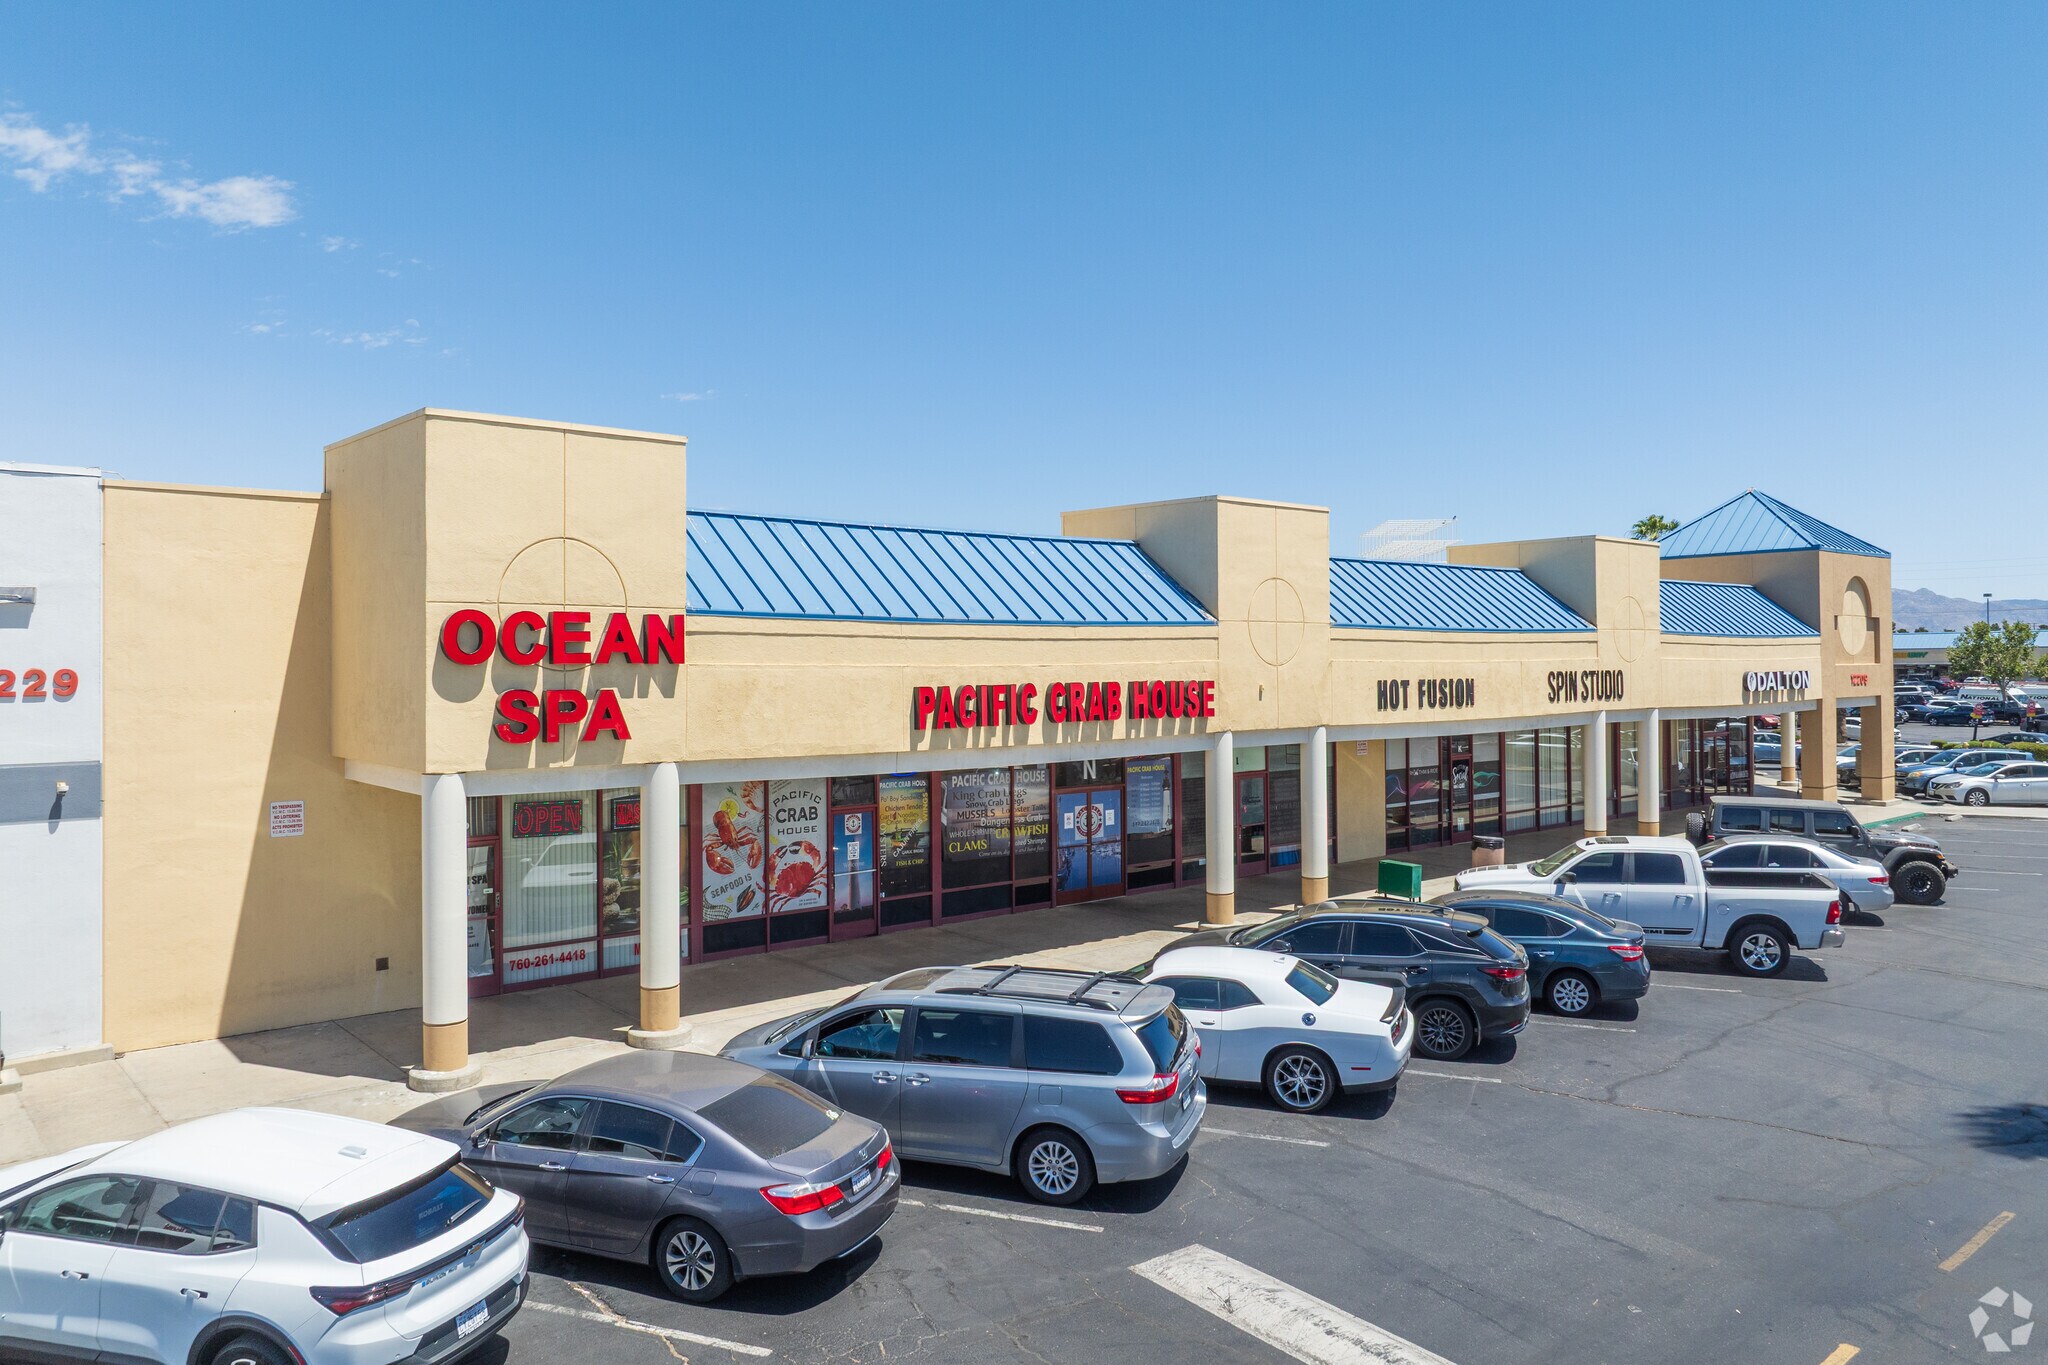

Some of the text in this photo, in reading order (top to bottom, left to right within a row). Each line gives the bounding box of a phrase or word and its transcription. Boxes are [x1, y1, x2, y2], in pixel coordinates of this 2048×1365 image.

[440, 609, 685, 666] OCEAN
[1377, 678, 1475, 711] HOT FUSION
[1548, 670, 1624, 703] SPIN STUDIO
[913, 680, 1216, 730] PACIFIC CRAB HOUSE
[494, 689, 632, 744] SPA
[1083, 760, 1097, 780] N
[912, 779, 927, 787] HOUS
[952, 774, 985, 788] PACIFIC
[988, 773, 1010, 785] CRAB
[1016, 770, 1045, 783] HOUSE
[772, 791, 822, 807] PACIFIC
[953, 791, 975, 802] King
[978, 789, 1000, 799] Crab
[988, 799, 1004, 808] Crab
[515, 804, 581, 835] OPEN
[776, 806, 818, 823] CRAB
[957, 809, 995, 820] MUSSELS
[1026, 814, 1043, 822] Crab
[777, 825, 818, 836] HOUSE
[949, 830, 971, 839] WHOLE
[893, 836, 910, 857] CAJUN
[949, 839, 987, 853] CLAMS
[471, 874, 488, 885] SPA
[711, 873, 752, 899] SEAFOOD IS
[509, 949, 586, 971] 760-261-4418
